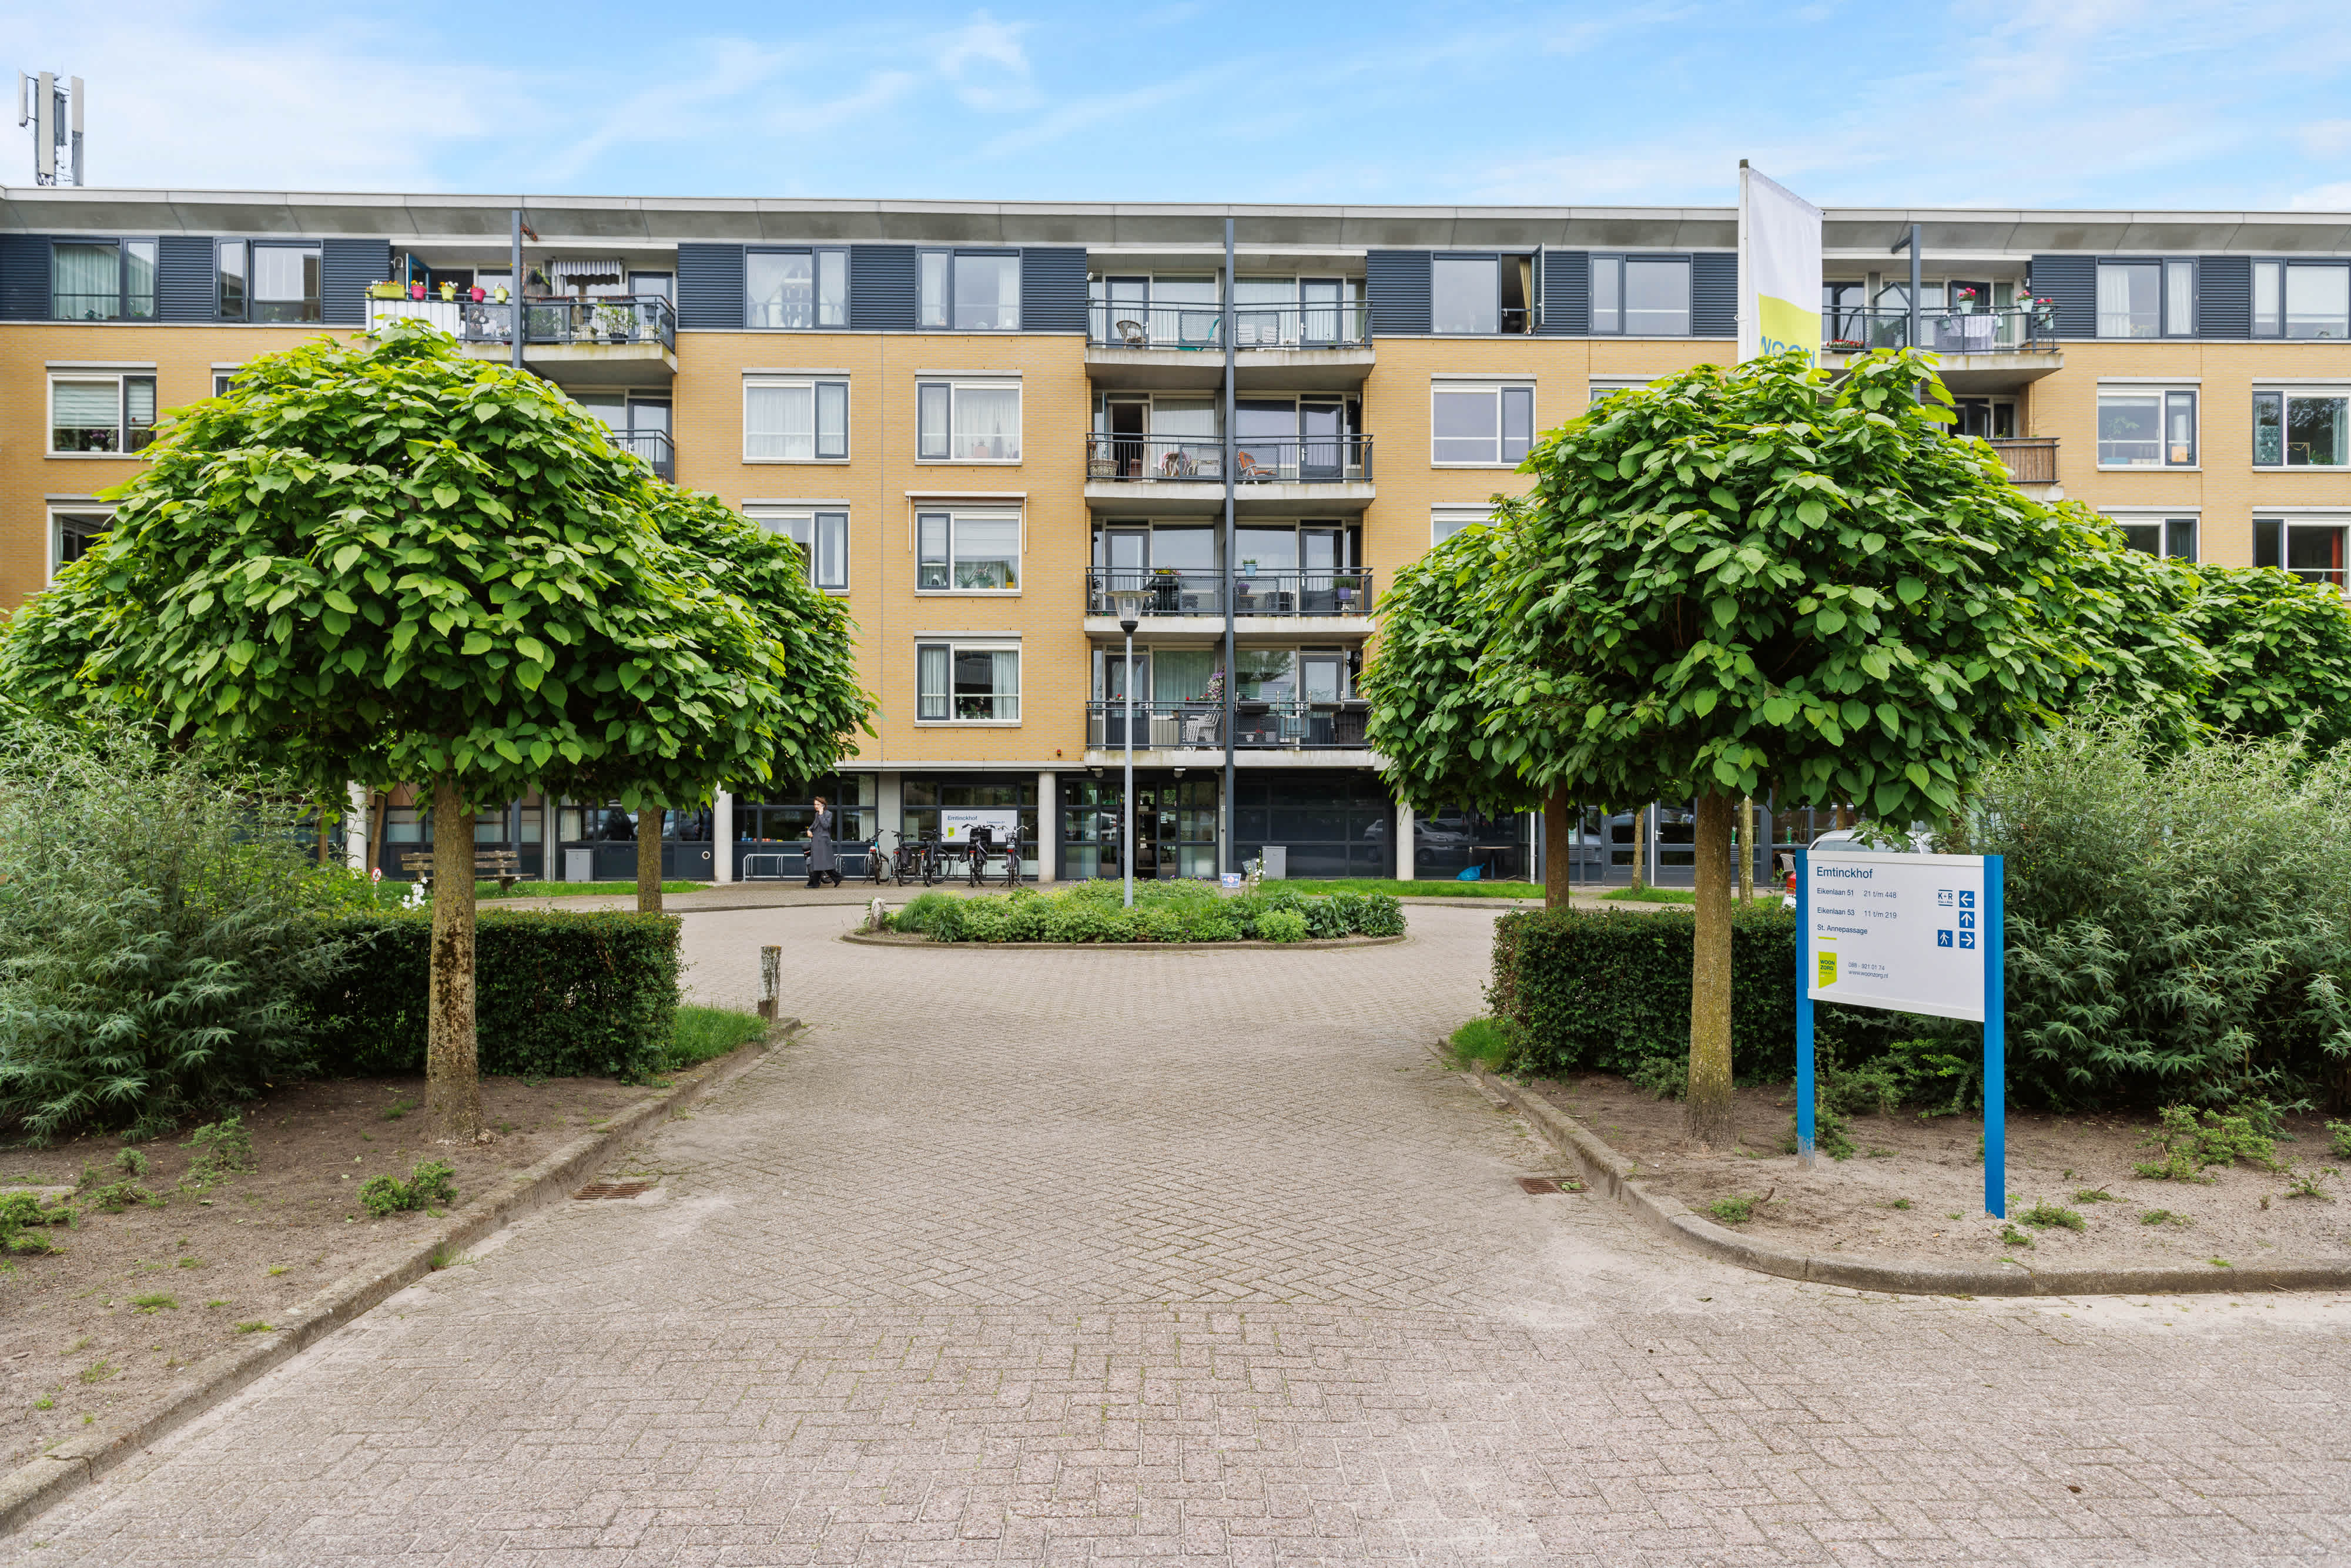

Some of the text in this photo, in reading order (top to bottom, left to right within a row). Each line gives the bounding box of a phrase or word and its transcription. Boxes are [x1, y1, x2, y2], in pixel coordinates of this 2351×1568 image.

[1817, 866, 1873, 879] Emtinckhof
[1817, 887, 1846, 896] Eikenlaan
[1817, 907, 1846, 915] Eikenlaan
[1827, 925, 1867, 935] Annepassage
